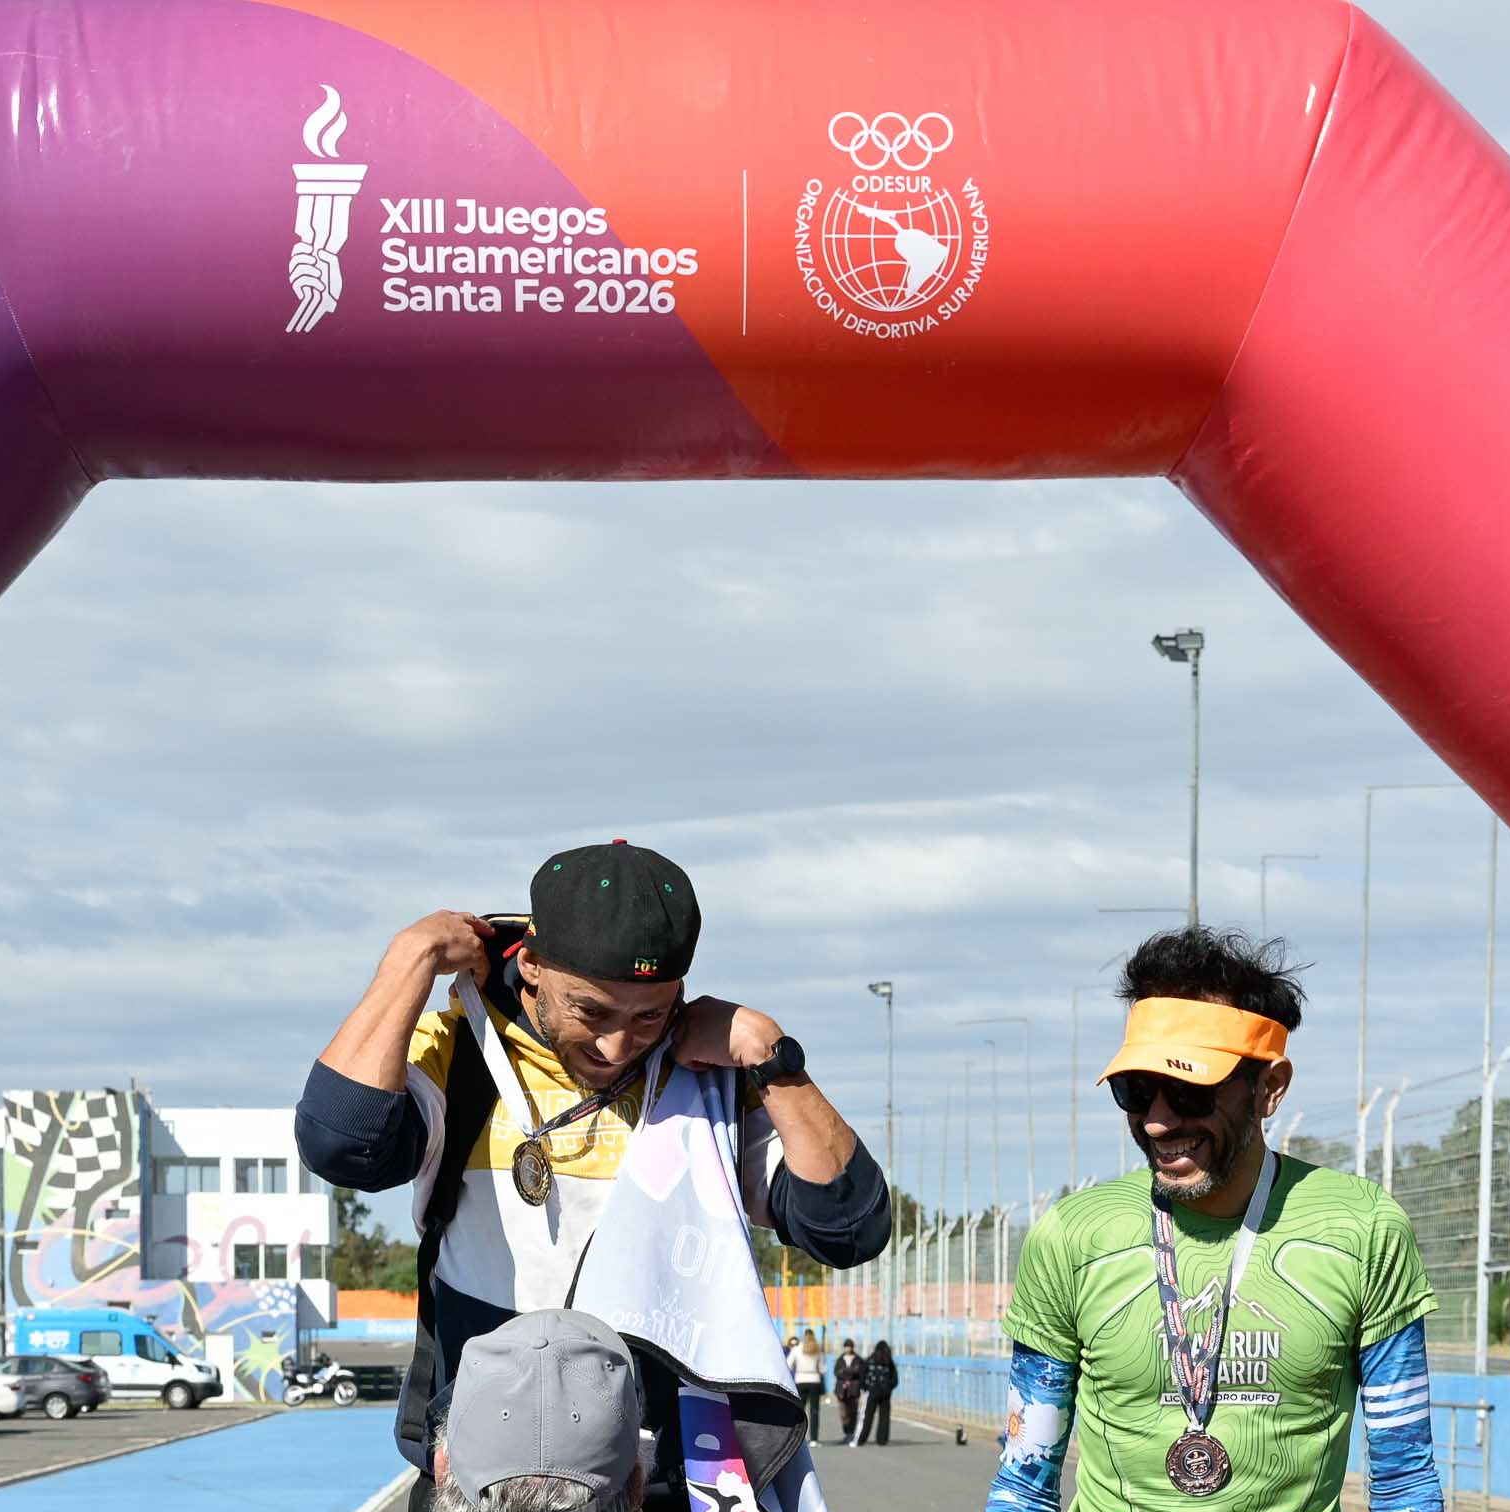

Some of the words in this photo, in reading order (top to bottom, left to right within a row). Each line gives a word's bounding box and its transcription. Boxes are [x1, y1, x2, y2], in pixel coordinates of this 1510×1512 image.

[852, 175, 932, 193] ODESUR
[379, 198, 444, 234] XIII
[455, 199, 607, 244] Juegos
[381, 236, 698, 276] Suramericanos
[795, 178, 845, 321] ORGANIZACION
[937, 177, 989, 320] SURAMERICANA
[383, 280, 502, 313] Santa
[514, 280, 565, 312] Fe
[575, 281, 675, 314] 2026
[842, 312, 940, 339] DEPORTIVA
[1229, 1331, 1280, 1359] RUN
[1241, 1393, 1276, 1403] RUFFO
